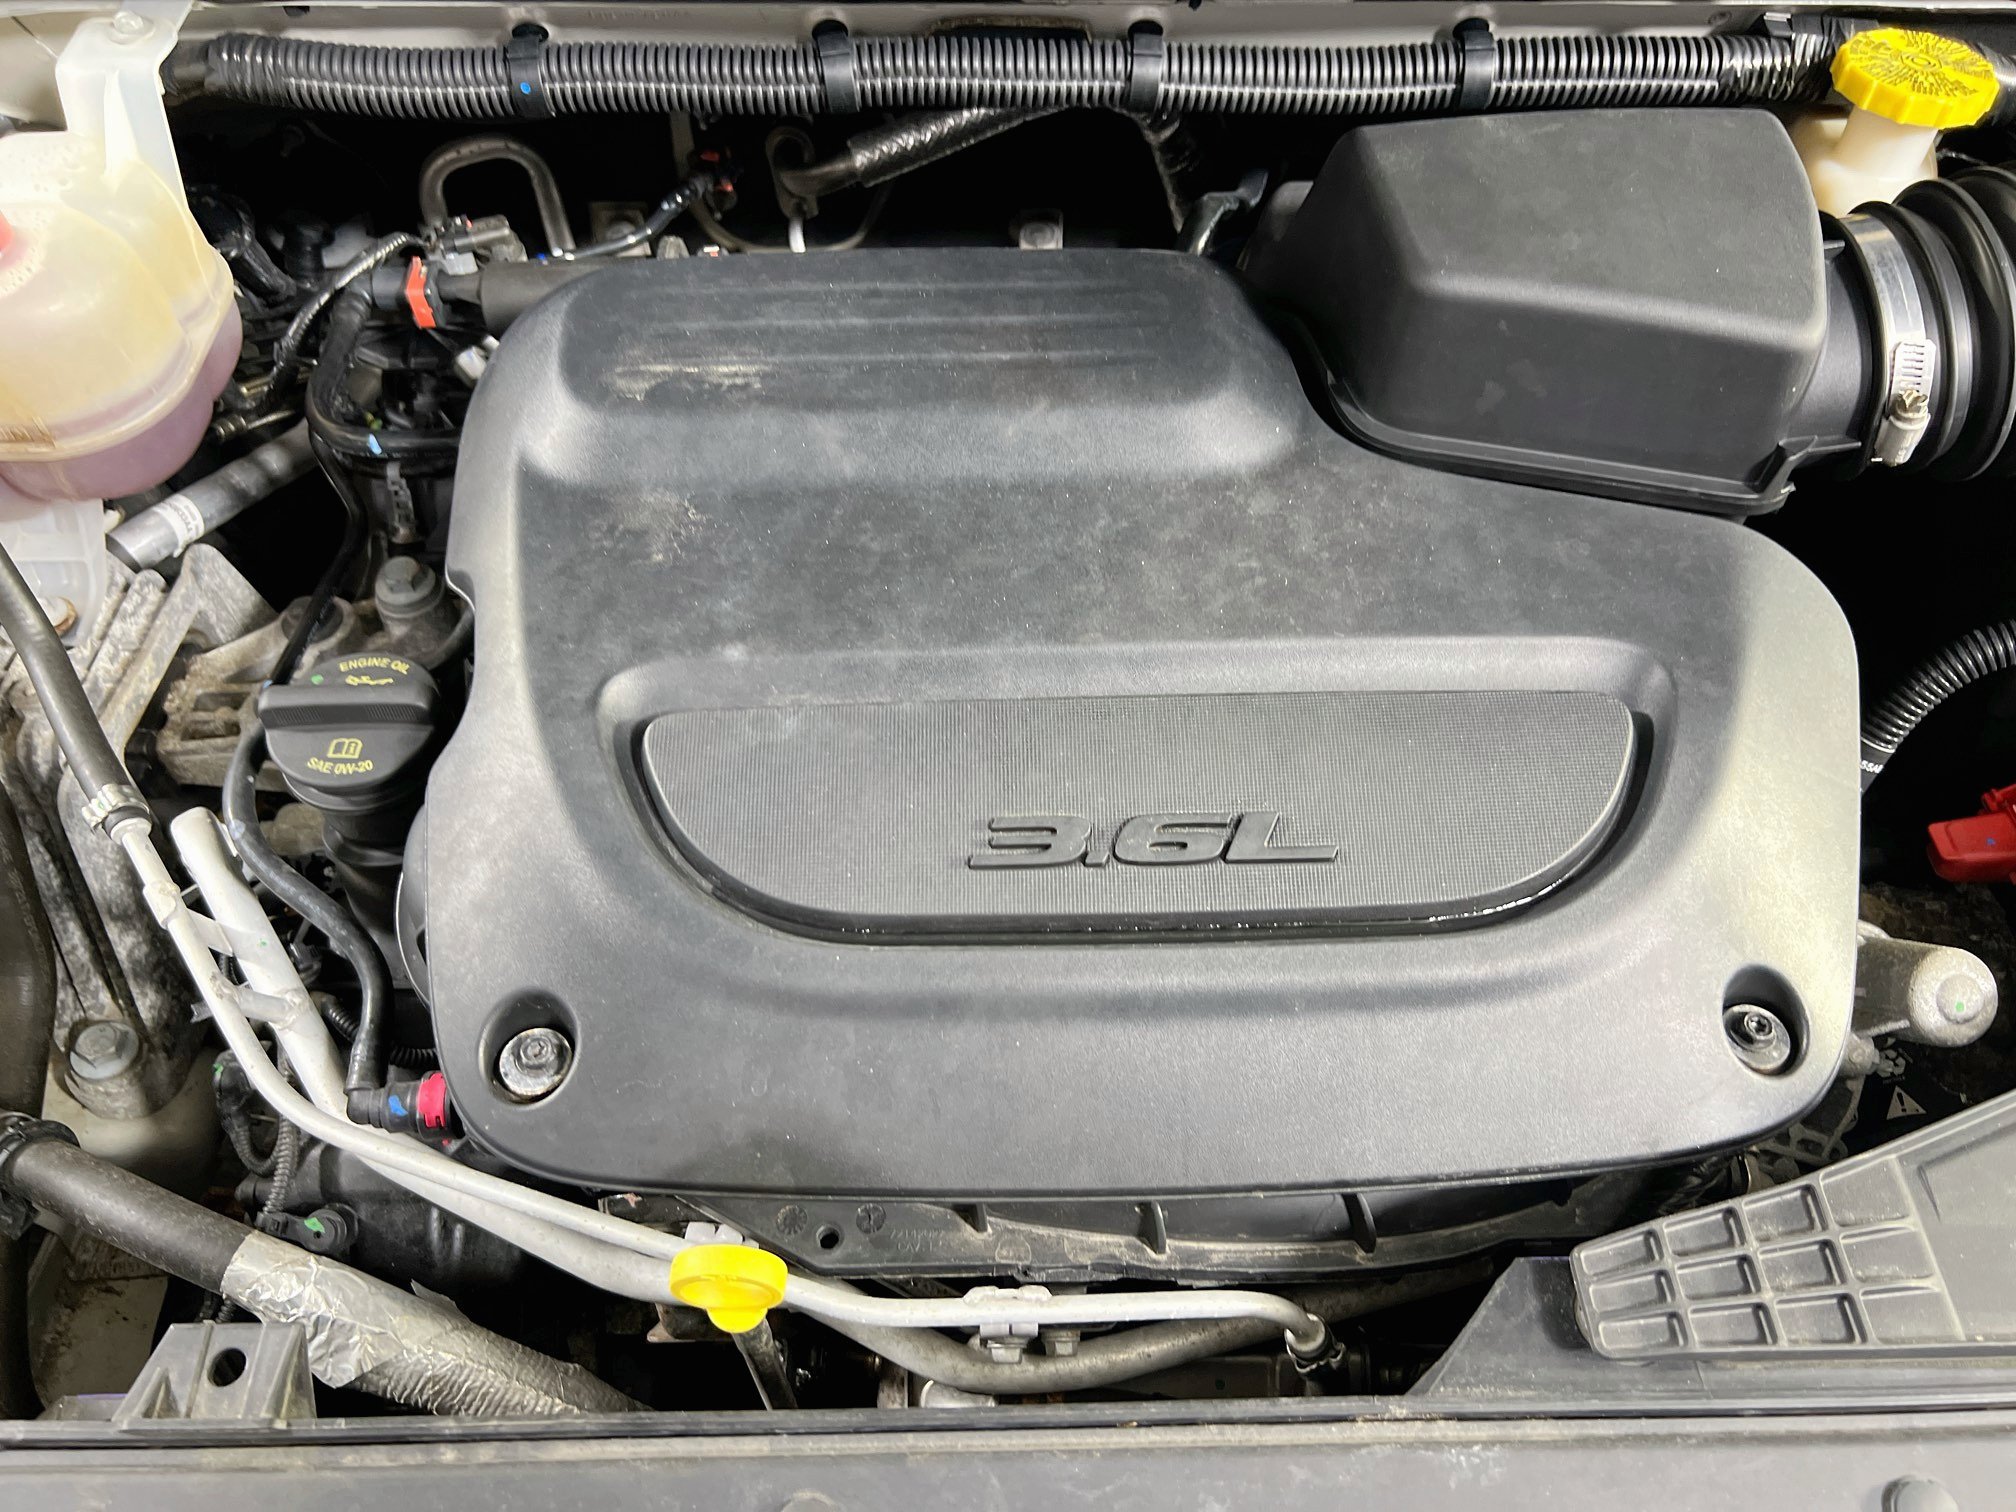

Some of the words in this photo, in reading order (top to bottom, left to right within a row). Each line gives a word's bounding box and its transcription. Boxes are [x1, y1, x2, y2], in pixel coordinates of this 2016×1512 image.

[339, 657, 391, 672] ENGINE
[391, 660, 410, 675] OIL
[307, 757, 333, 774] SAE
[334, 759, 374, 775] 0W-20
[968, 811, 1339, 869] 3.6L
